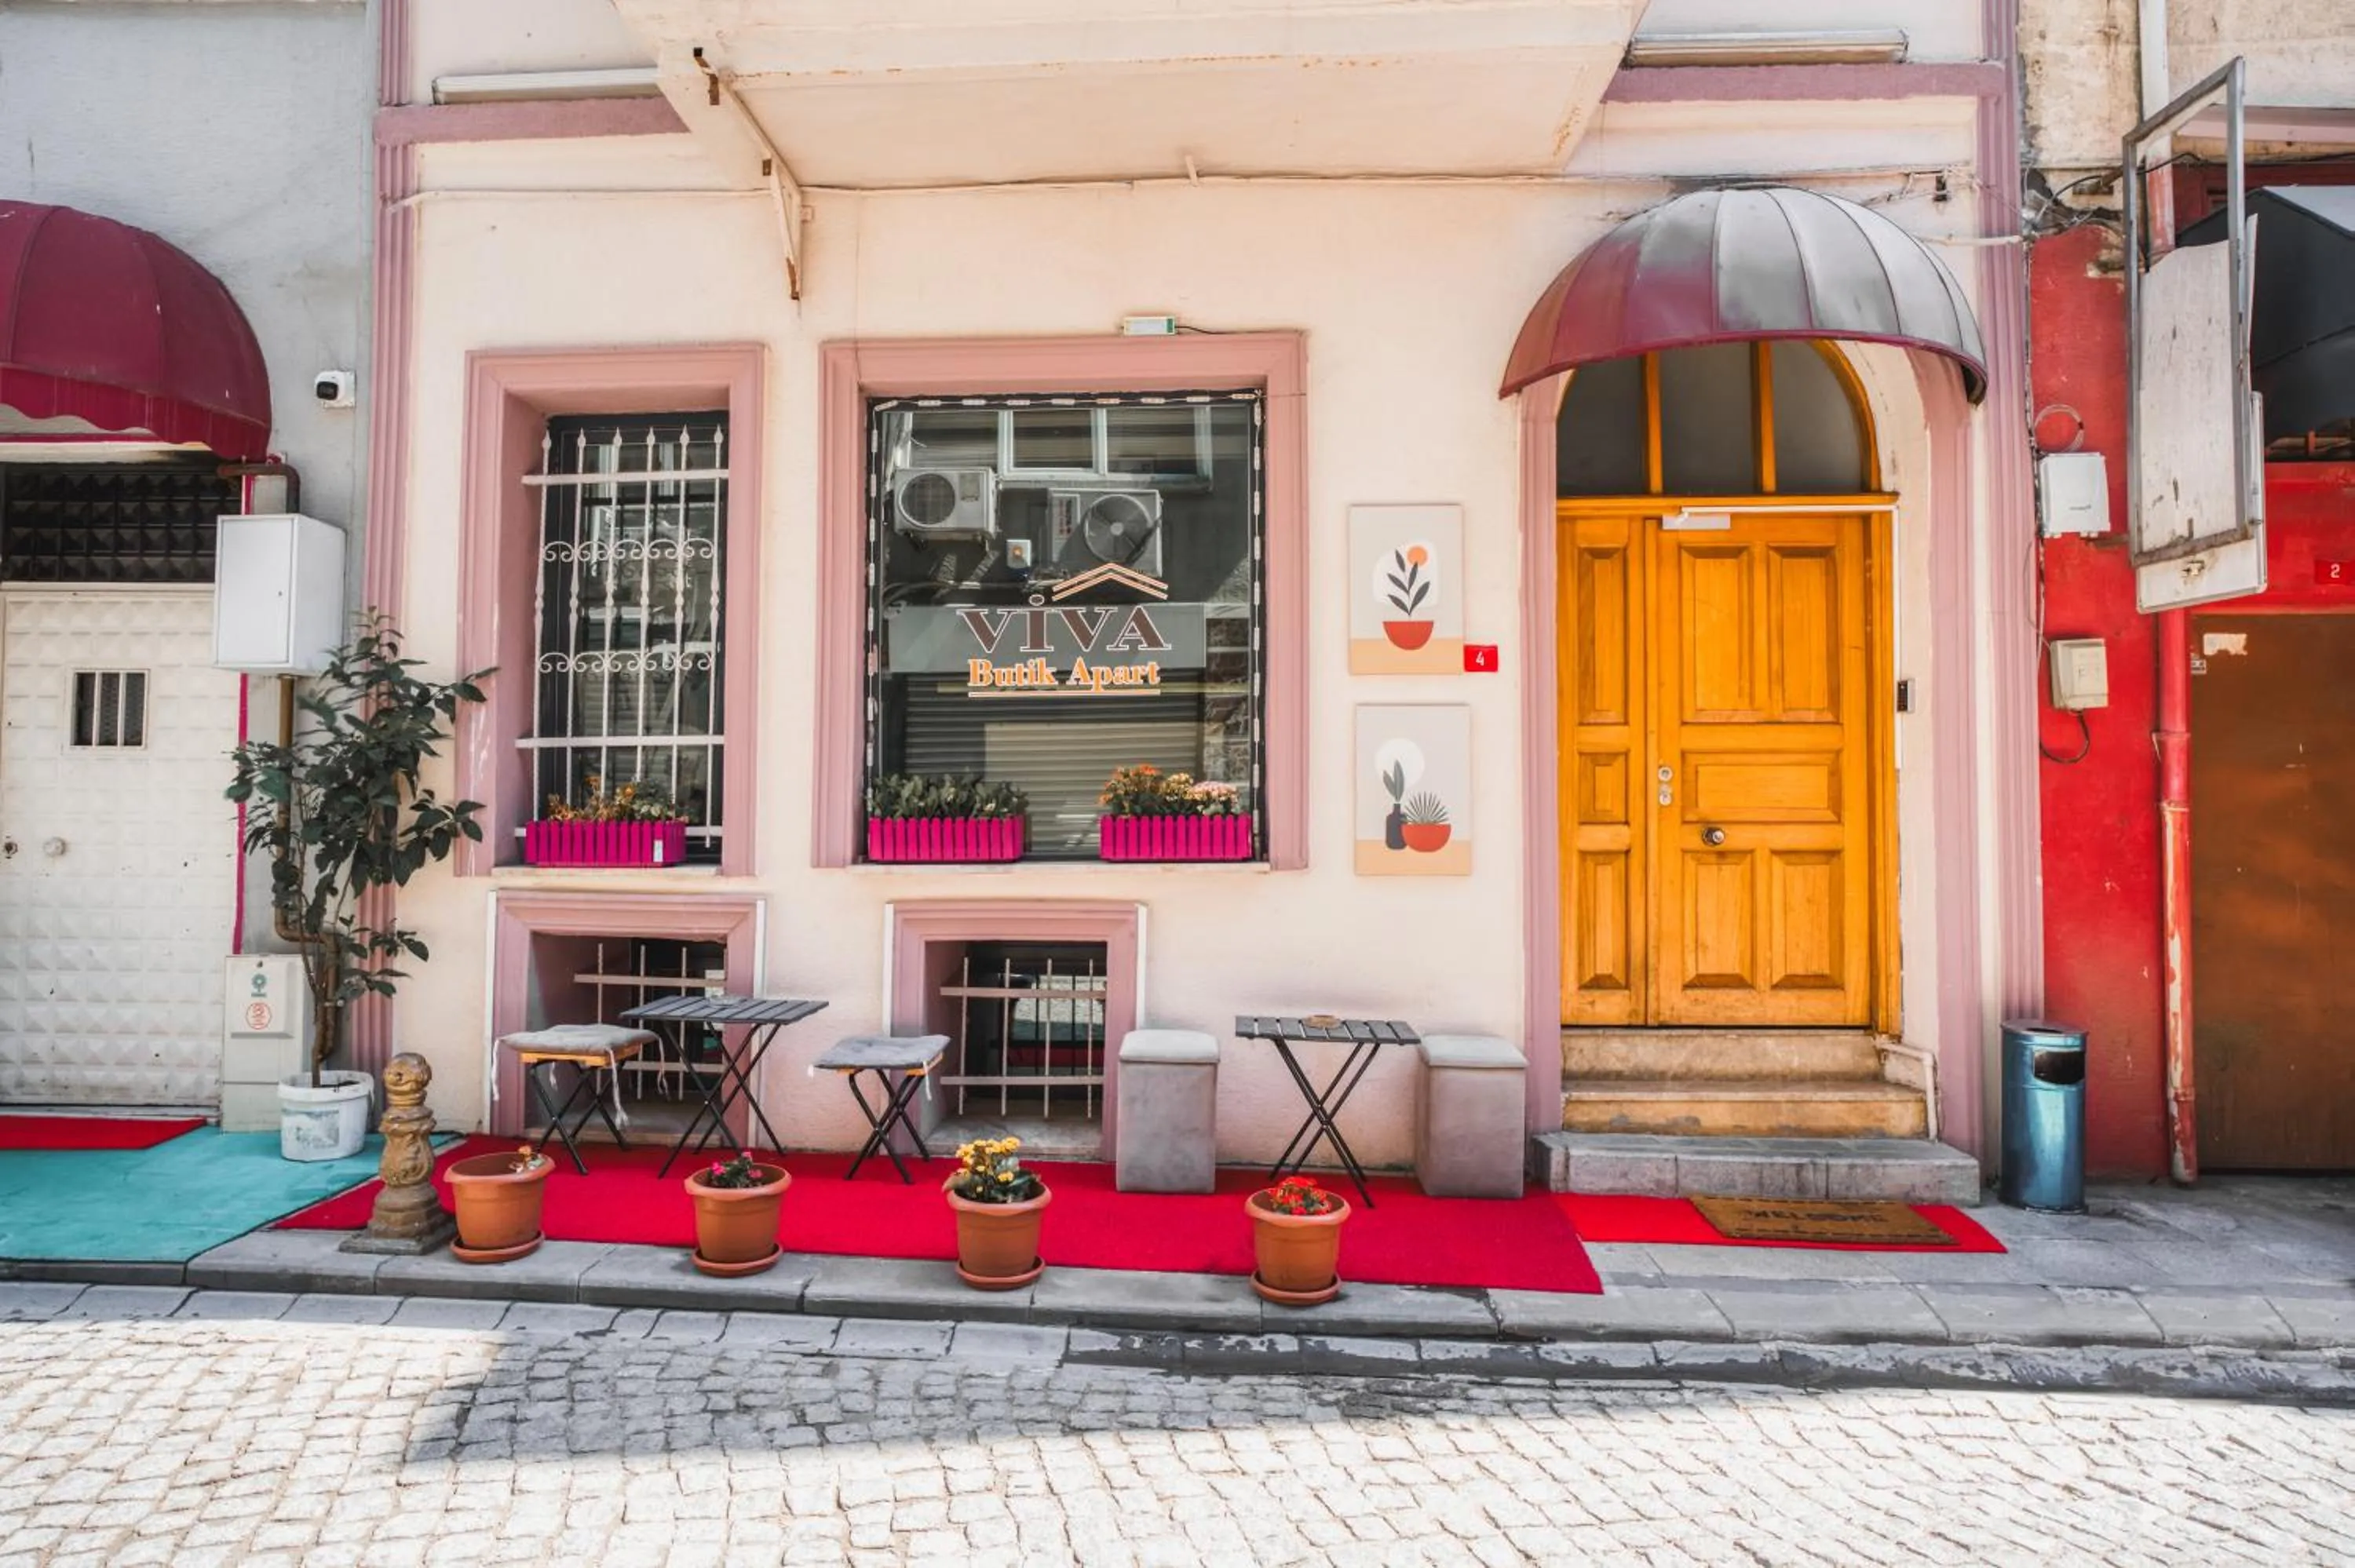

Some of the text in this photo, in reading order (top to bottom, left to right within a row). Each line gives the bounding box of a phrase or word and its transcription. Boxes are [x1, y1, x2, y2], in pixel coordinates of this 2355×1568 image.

[2331, 563, 2340, 578] 2
[956, 594, 1172, 654] VİVA
[1476, 651, 1484, 666] 4
[967, 656, 1161, 692] Butik Apart
